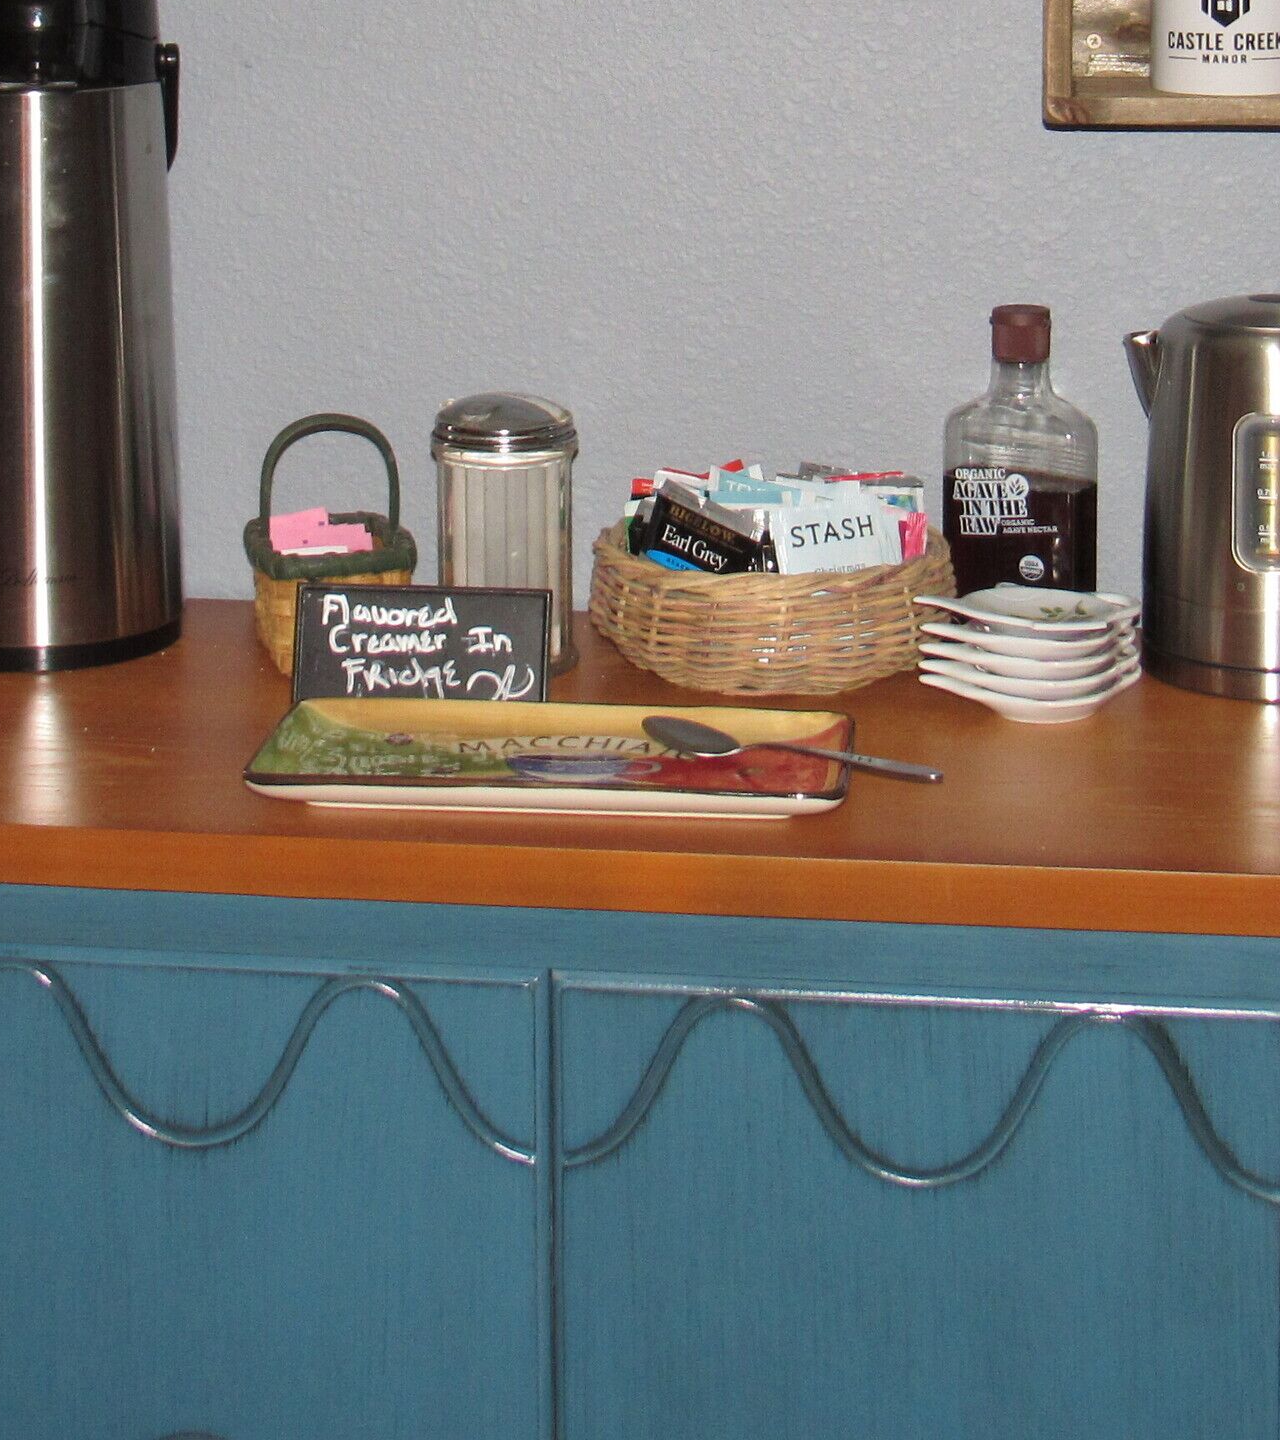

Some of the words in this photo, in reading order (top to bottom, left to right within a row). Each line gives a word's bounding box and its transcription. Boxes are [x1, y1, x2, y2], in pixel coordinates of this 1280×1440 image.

[1168, 31, 1224, 51] CASTLE
[1202, 54, 1248, 64] MANOR
[955, 468, 1006, 480] ORGANIC
[953, 481, 1008, 500] AGAVE
[962, 499, 982, 517] IN
[985, 498, 1028, 517] THE
[790, 514, 875, 548] STASH
[960, 516, 999, 535] RAW
[661, 523, 693, 552] Earl
[692, 540, 728, 571] Grey
[322, 593, 457, 628] Flavored
[329, 623, 447, 654] Creamer
[468, 626, 513, 653] In
